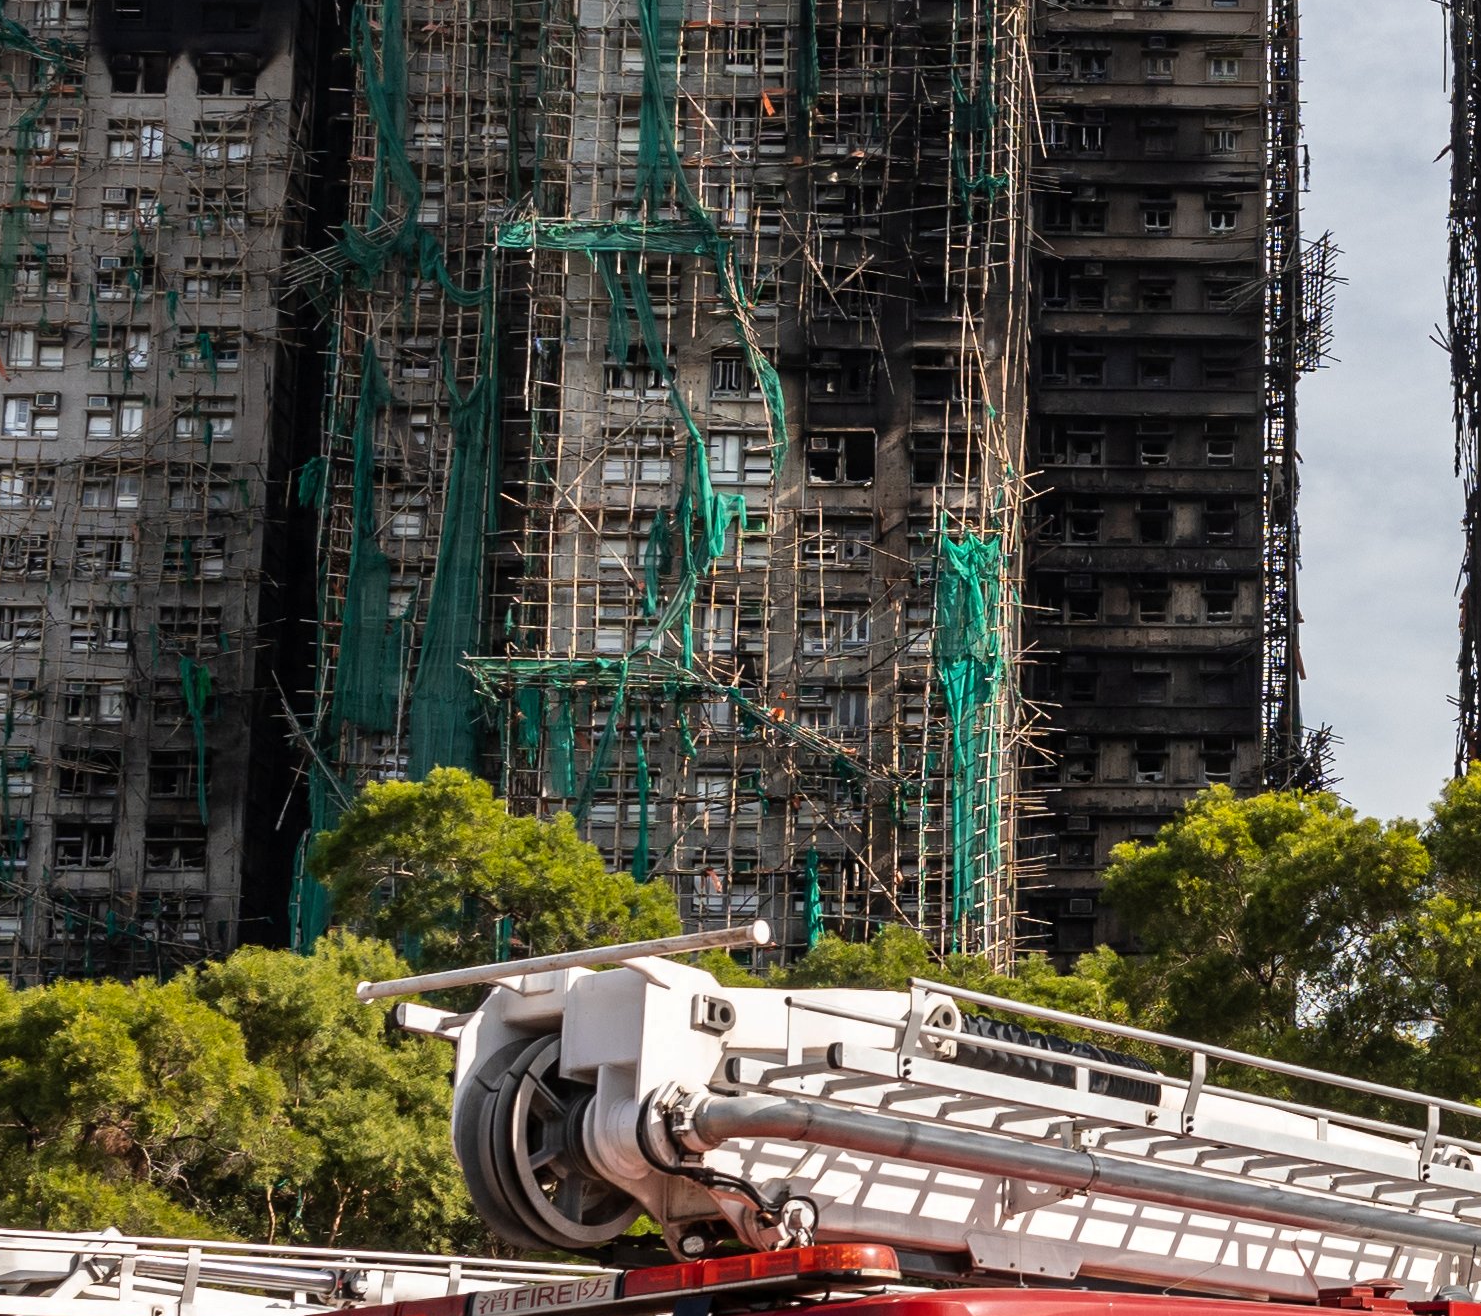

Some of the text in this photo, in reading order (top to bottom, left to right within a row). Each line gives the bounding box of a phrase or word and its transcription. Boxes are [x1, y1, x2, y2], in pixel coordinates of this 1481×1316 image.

[479, 1278, 612, 1315] 消 FIRE 防
